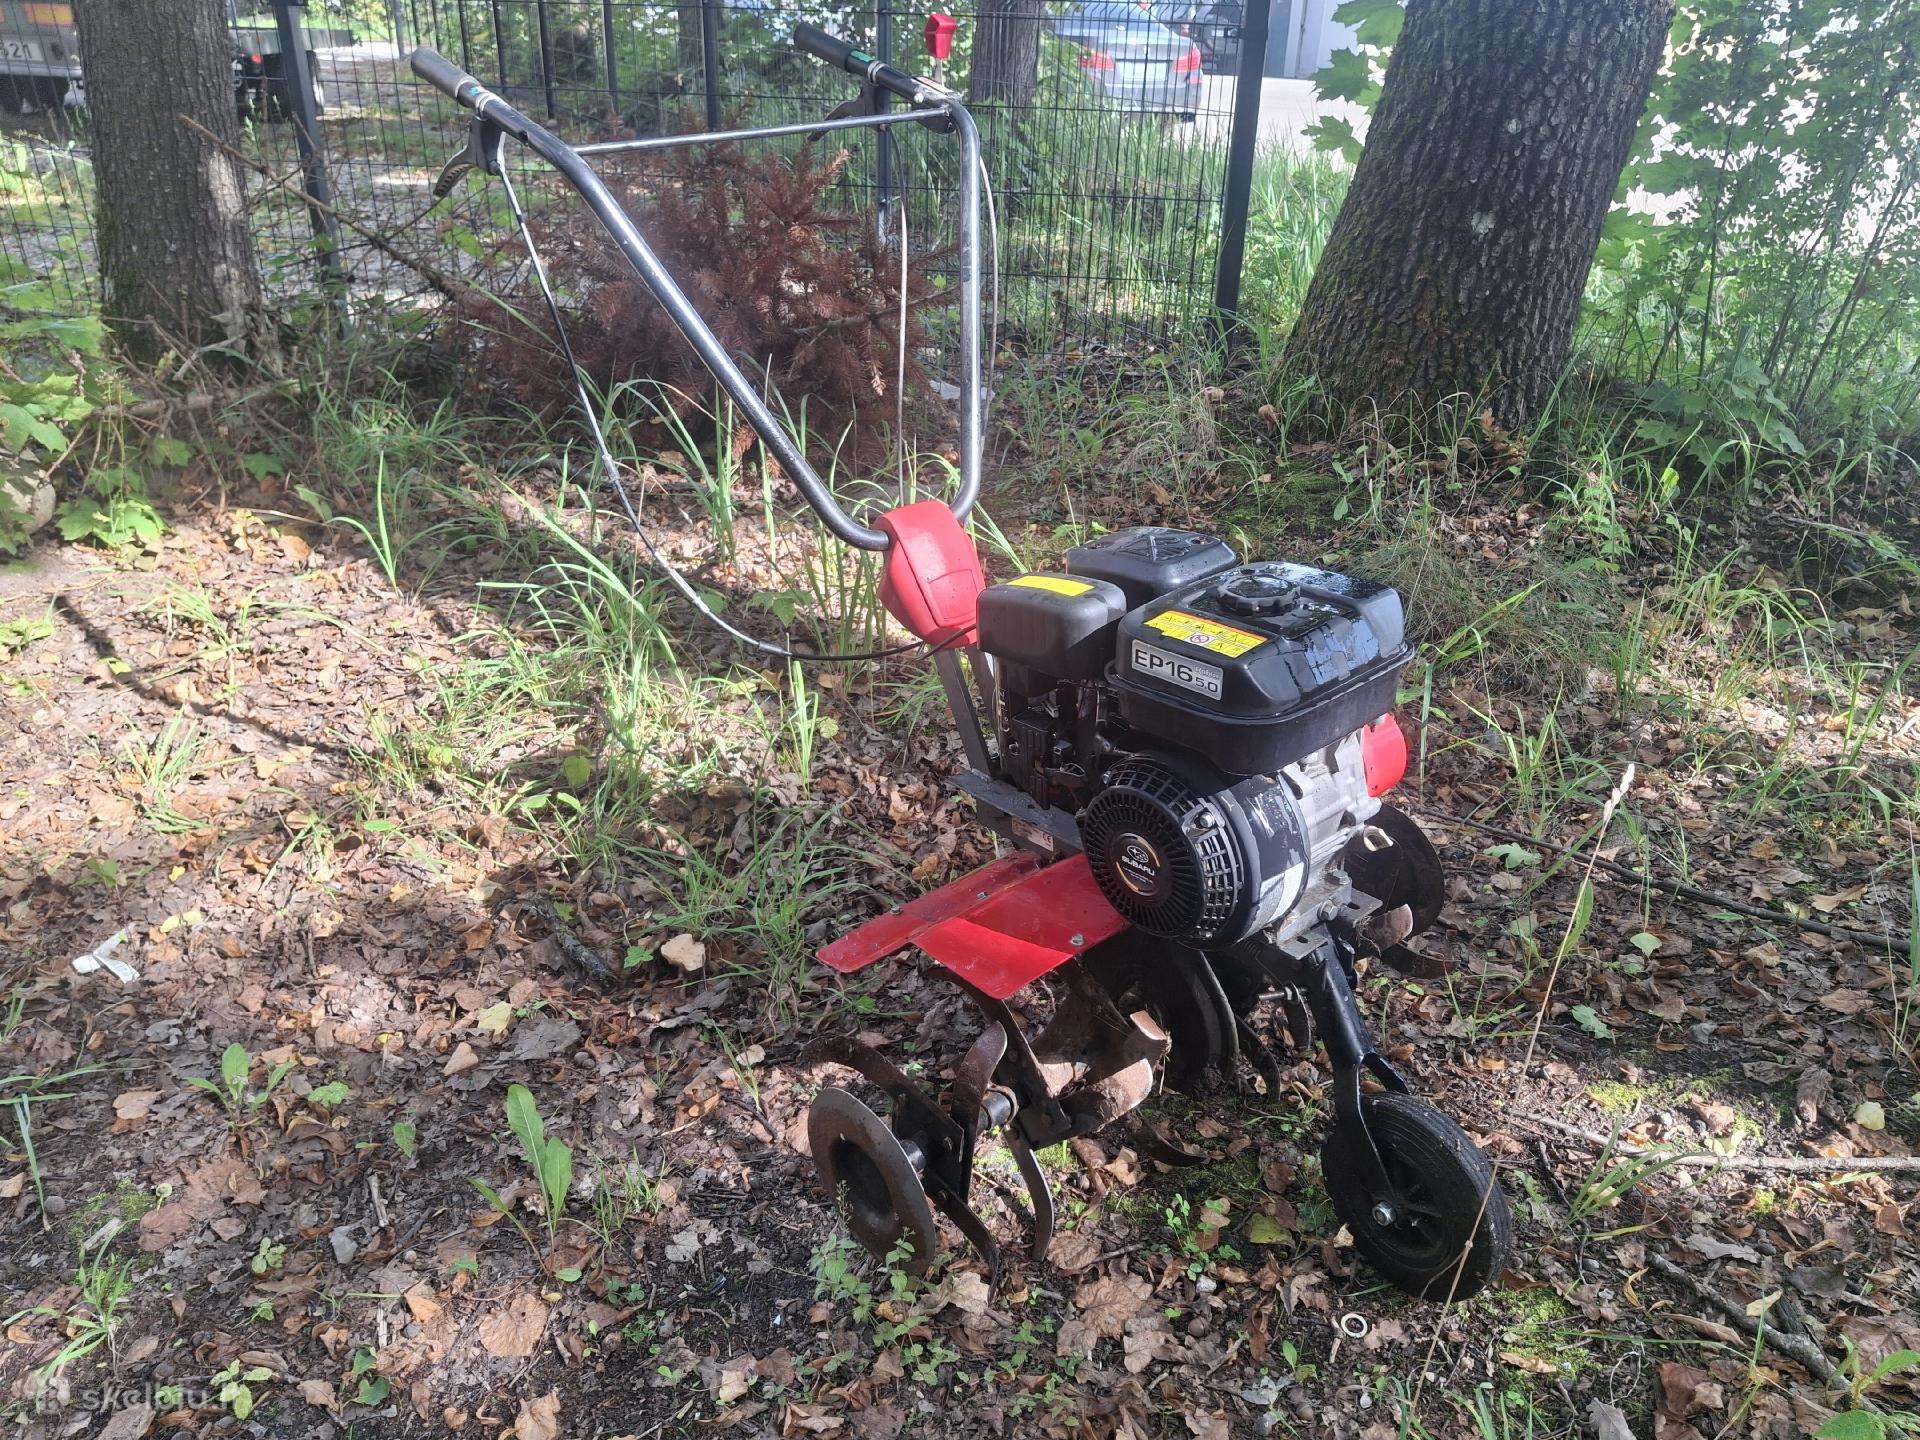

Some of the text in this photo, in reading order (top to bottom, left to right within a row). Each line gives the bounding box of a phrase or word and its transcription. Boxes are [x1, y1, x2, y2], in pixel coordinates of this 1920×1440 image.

[1134, 648, 1218, 693] EP16 5.0
[1121, 855, 1155, 876] SUBARU
